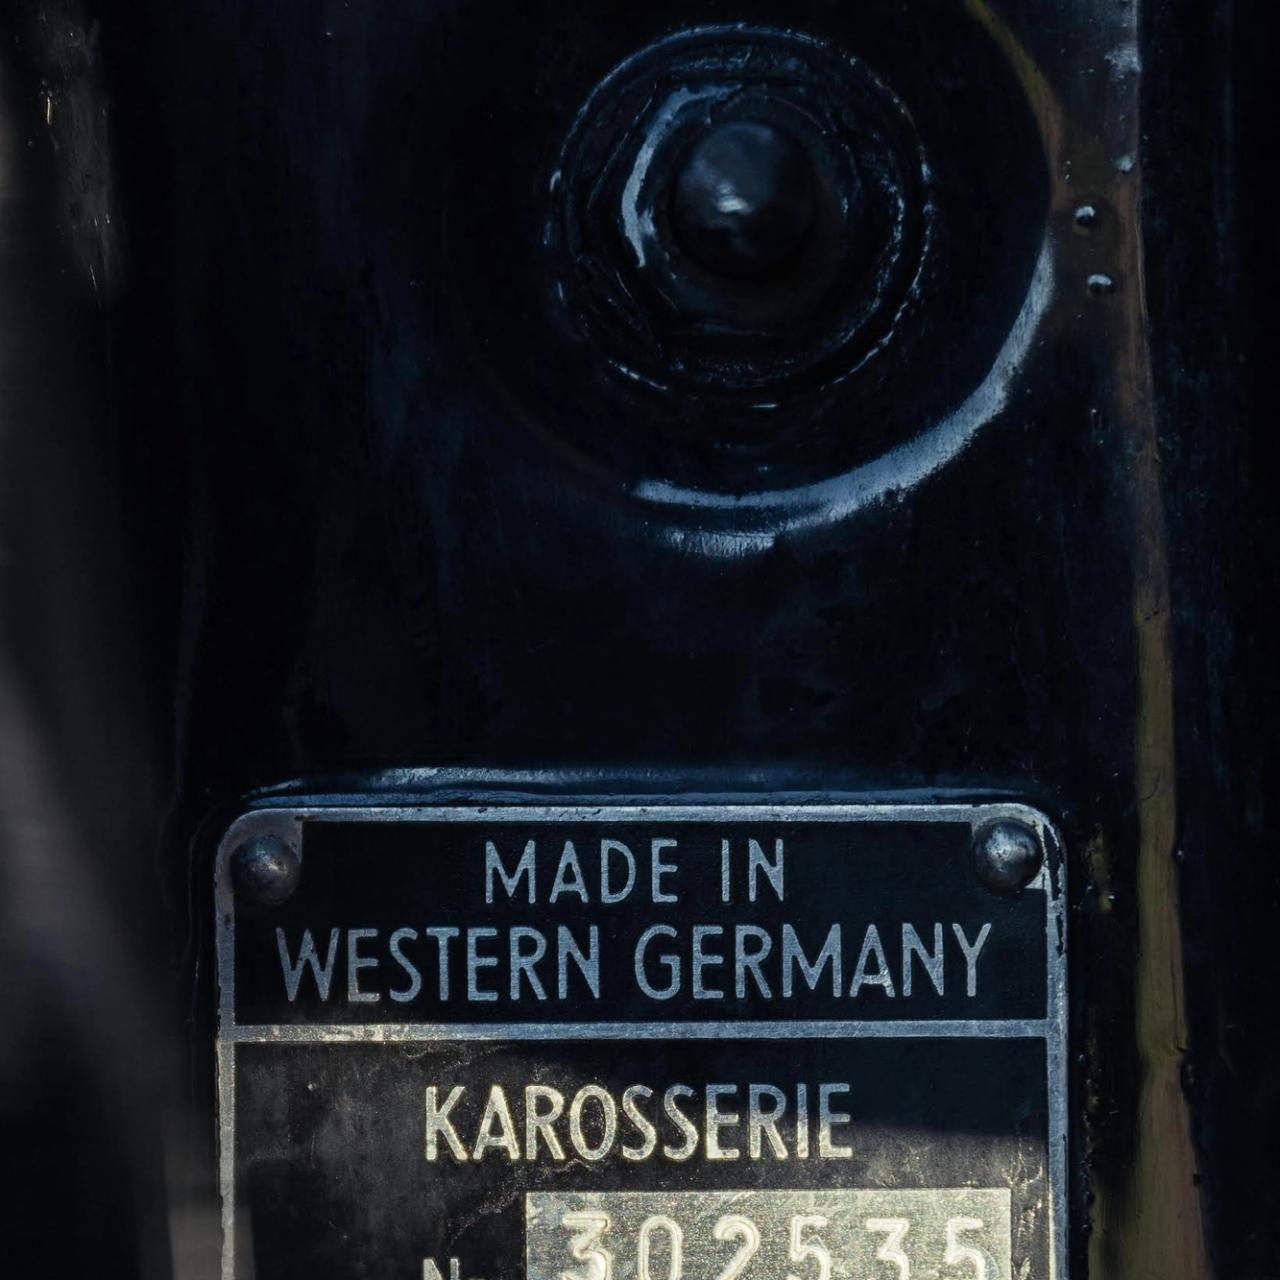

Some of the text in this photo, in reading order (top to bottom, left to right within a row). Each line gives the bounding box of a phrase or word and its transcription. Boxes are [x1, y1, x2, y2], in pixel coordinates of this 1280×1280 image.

[483, 837, 786, 905] MADE IN
[275, 922, 993, 1002] WESTERN GERMANY
[424, 1082, 854, 1163] KAROSSERIE
